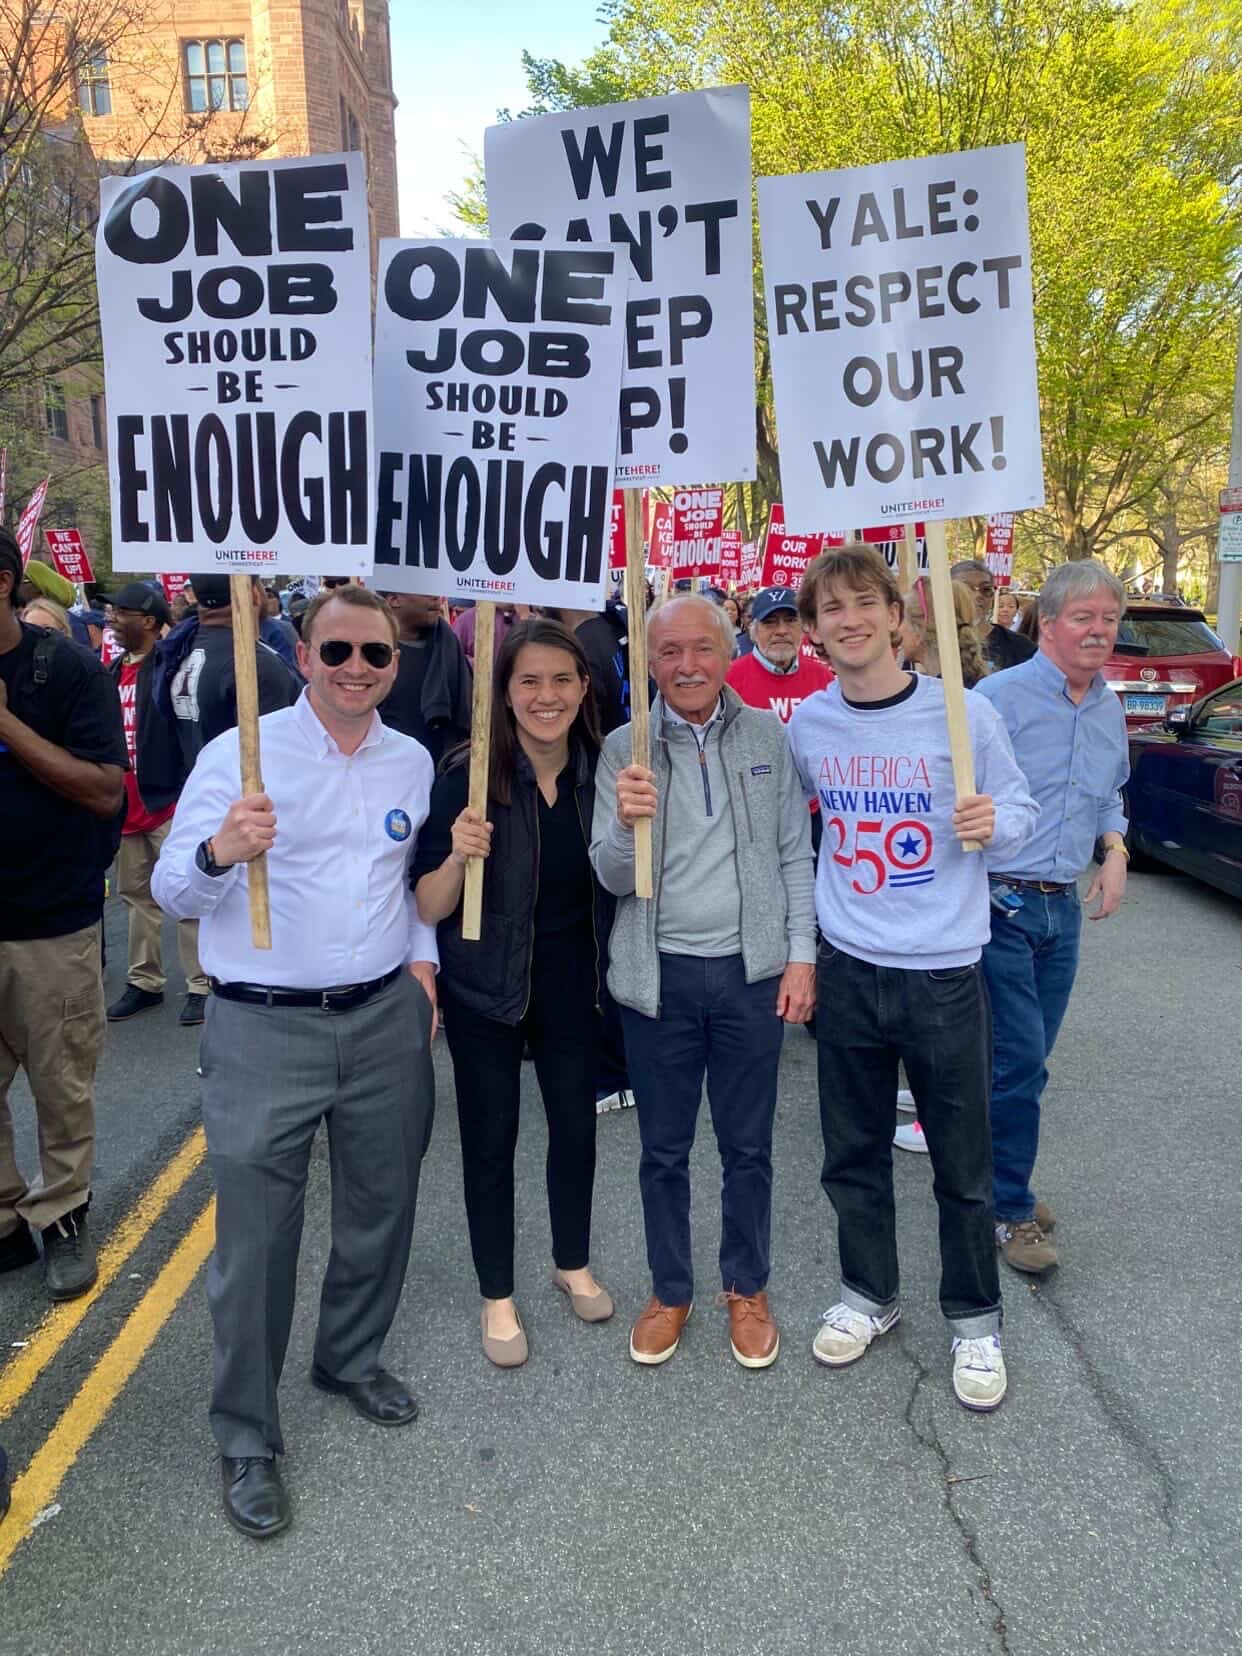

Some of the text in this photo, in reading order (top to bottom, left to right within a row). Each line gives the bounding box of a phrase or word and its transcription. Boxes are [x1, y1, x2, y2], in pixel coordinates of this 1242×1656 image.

[561, 113, 672, 201] WE
[103, 164, 354, 264] ONE
[510, 199, 738, 282] N'T
[805, 180, 979, 250] YALE:
[137, 262, 337, 323] JOB
[384, 245, 615, 325] ONE
[773, 255, 1022, 336] RESPECT
[164, 328, 317, 365] SHOULD
[406, 328, 591, 378] JOB
[626, 295, 712, 369] EP
[216, 370, 263, 404] BE
[425, 381, 569, 418] SHOULD
[842, 346, 965, 407] OUR
[471, 421, 516, 453] BE
[619, 377, 689, 455] P!
[117, 410, 368, 545] ENOUGH
[615, 464, 661, 476] ITEHERE!
[813, 416, 1004, 489] WORK!
[375, 450, 609, 583] ENOUGH
[674, 491, 722, 511] ONE
[679, 509, 718, 523] JOB
[673, 537, 720, 569] ENOUGH
[781, 539, 807, 553] OUR
[818, 756, 932, 788] AMERICA
[820, 790, 932, 813] NEW HAVEN
[828, 816, 933, 895] 250
